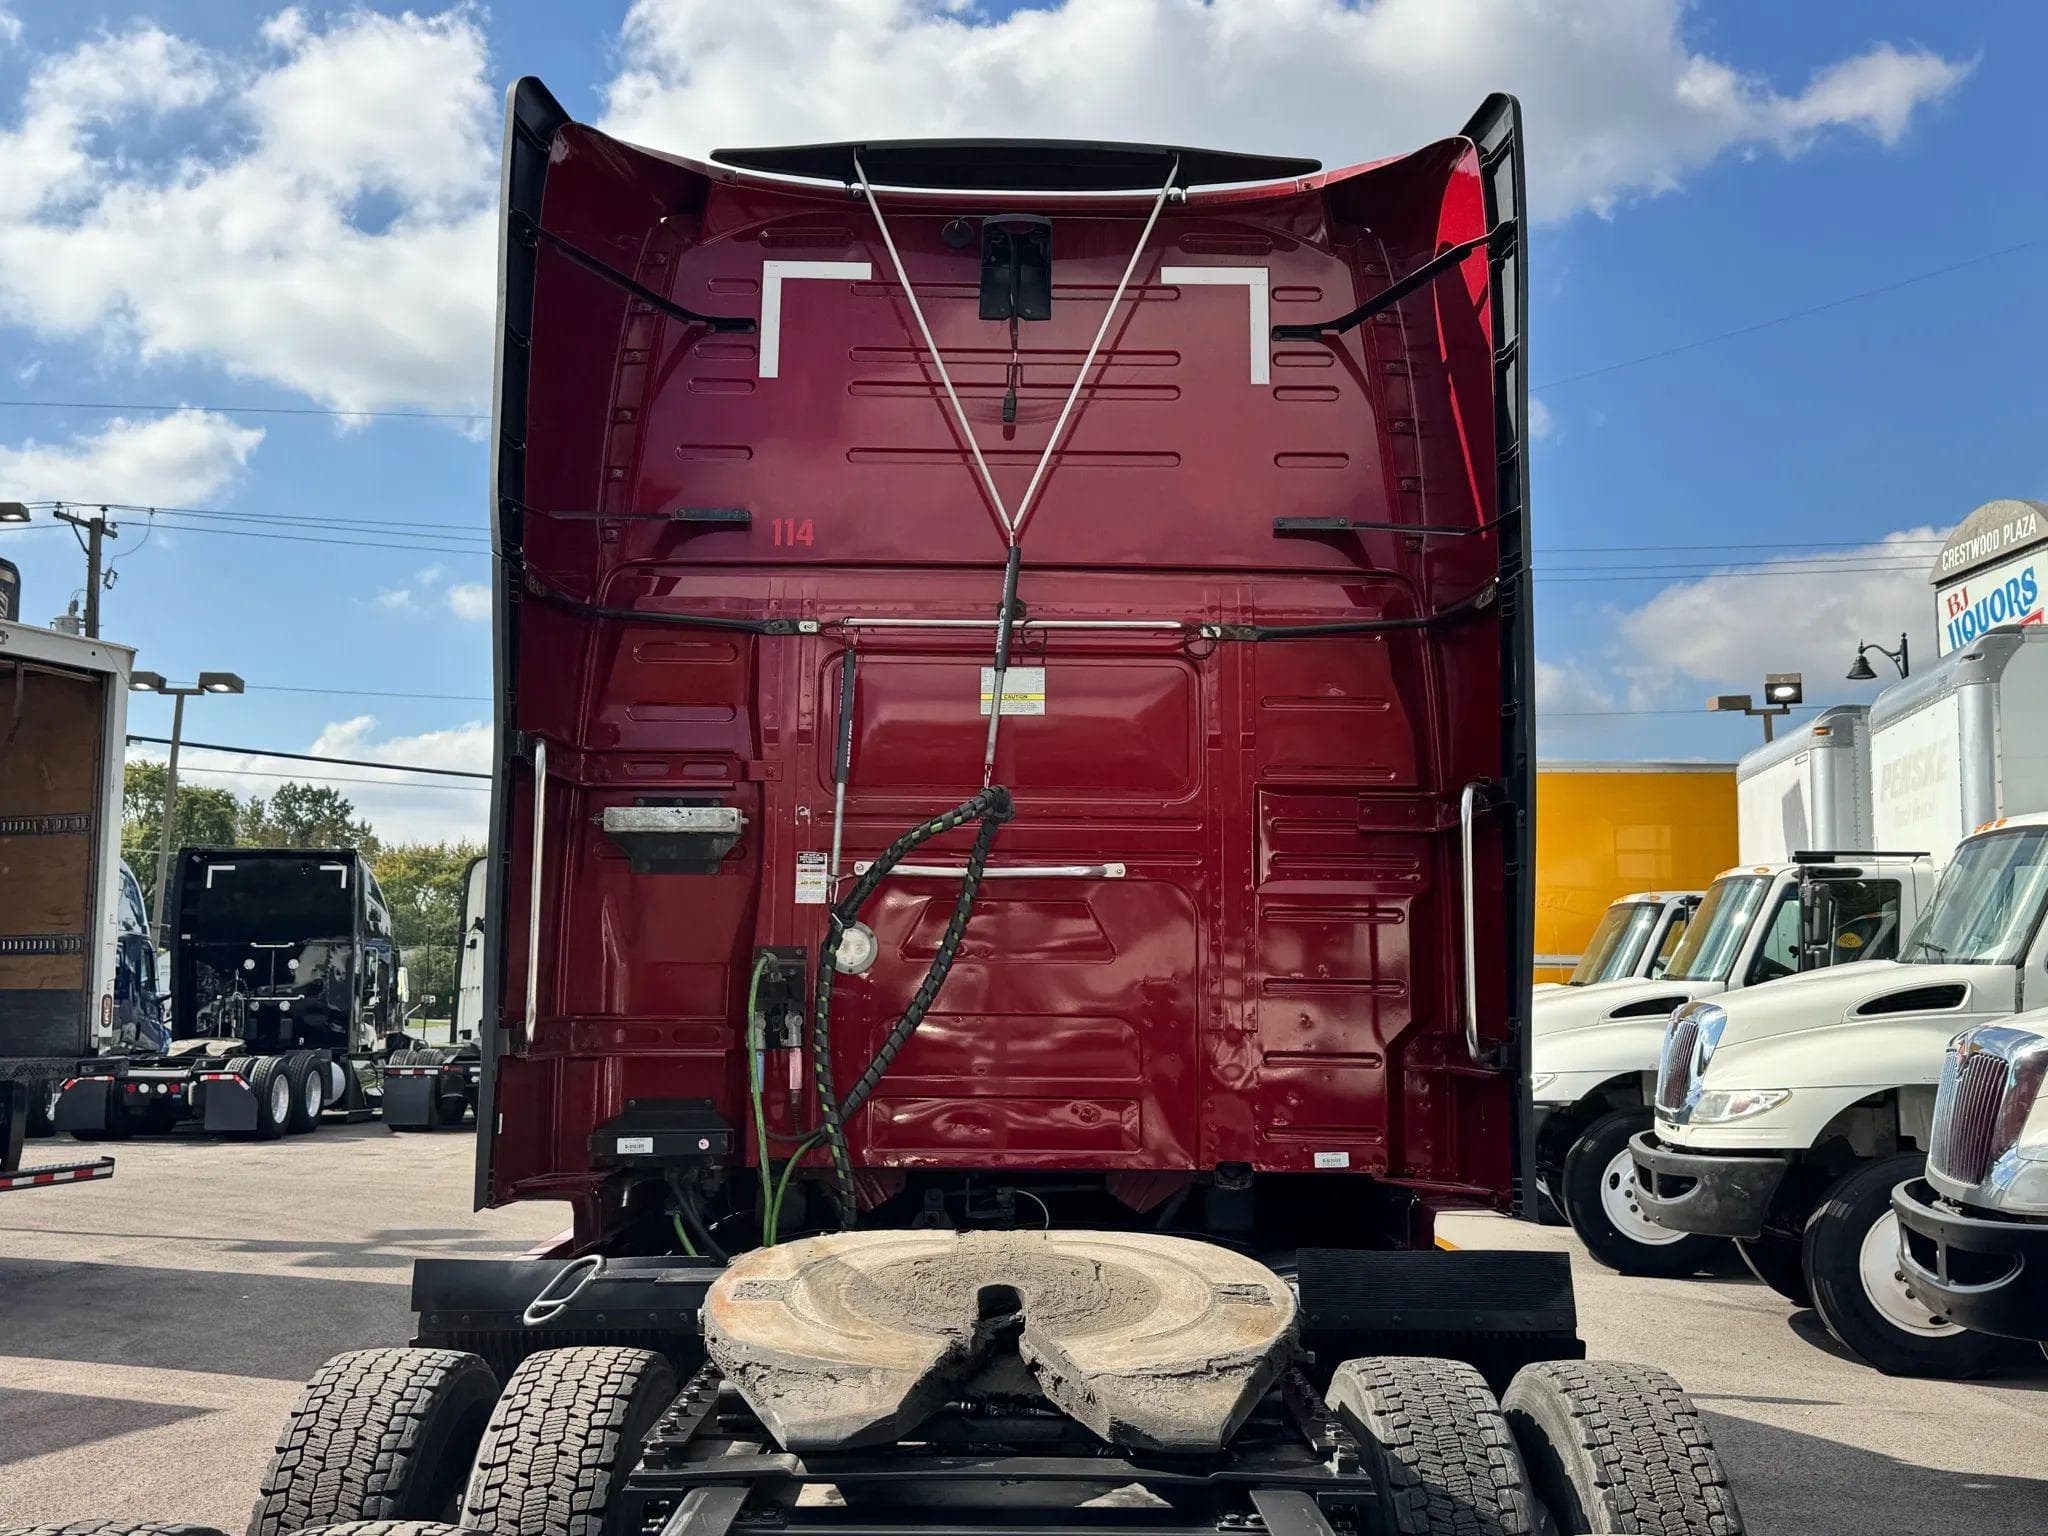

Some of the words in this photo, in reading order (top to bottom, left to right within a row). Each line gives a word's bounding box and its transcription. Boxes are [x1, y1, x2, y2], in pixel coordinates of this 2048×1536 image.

[772, 518, 814, 546] 114
[1942, 528, 2000, 571] CRESTWOOD
[2003, 513, 2037, 546] PLAZA
[1946, 586, 1969, 619] BJ
[1947, 566, 2038, 650] LIQUORS
